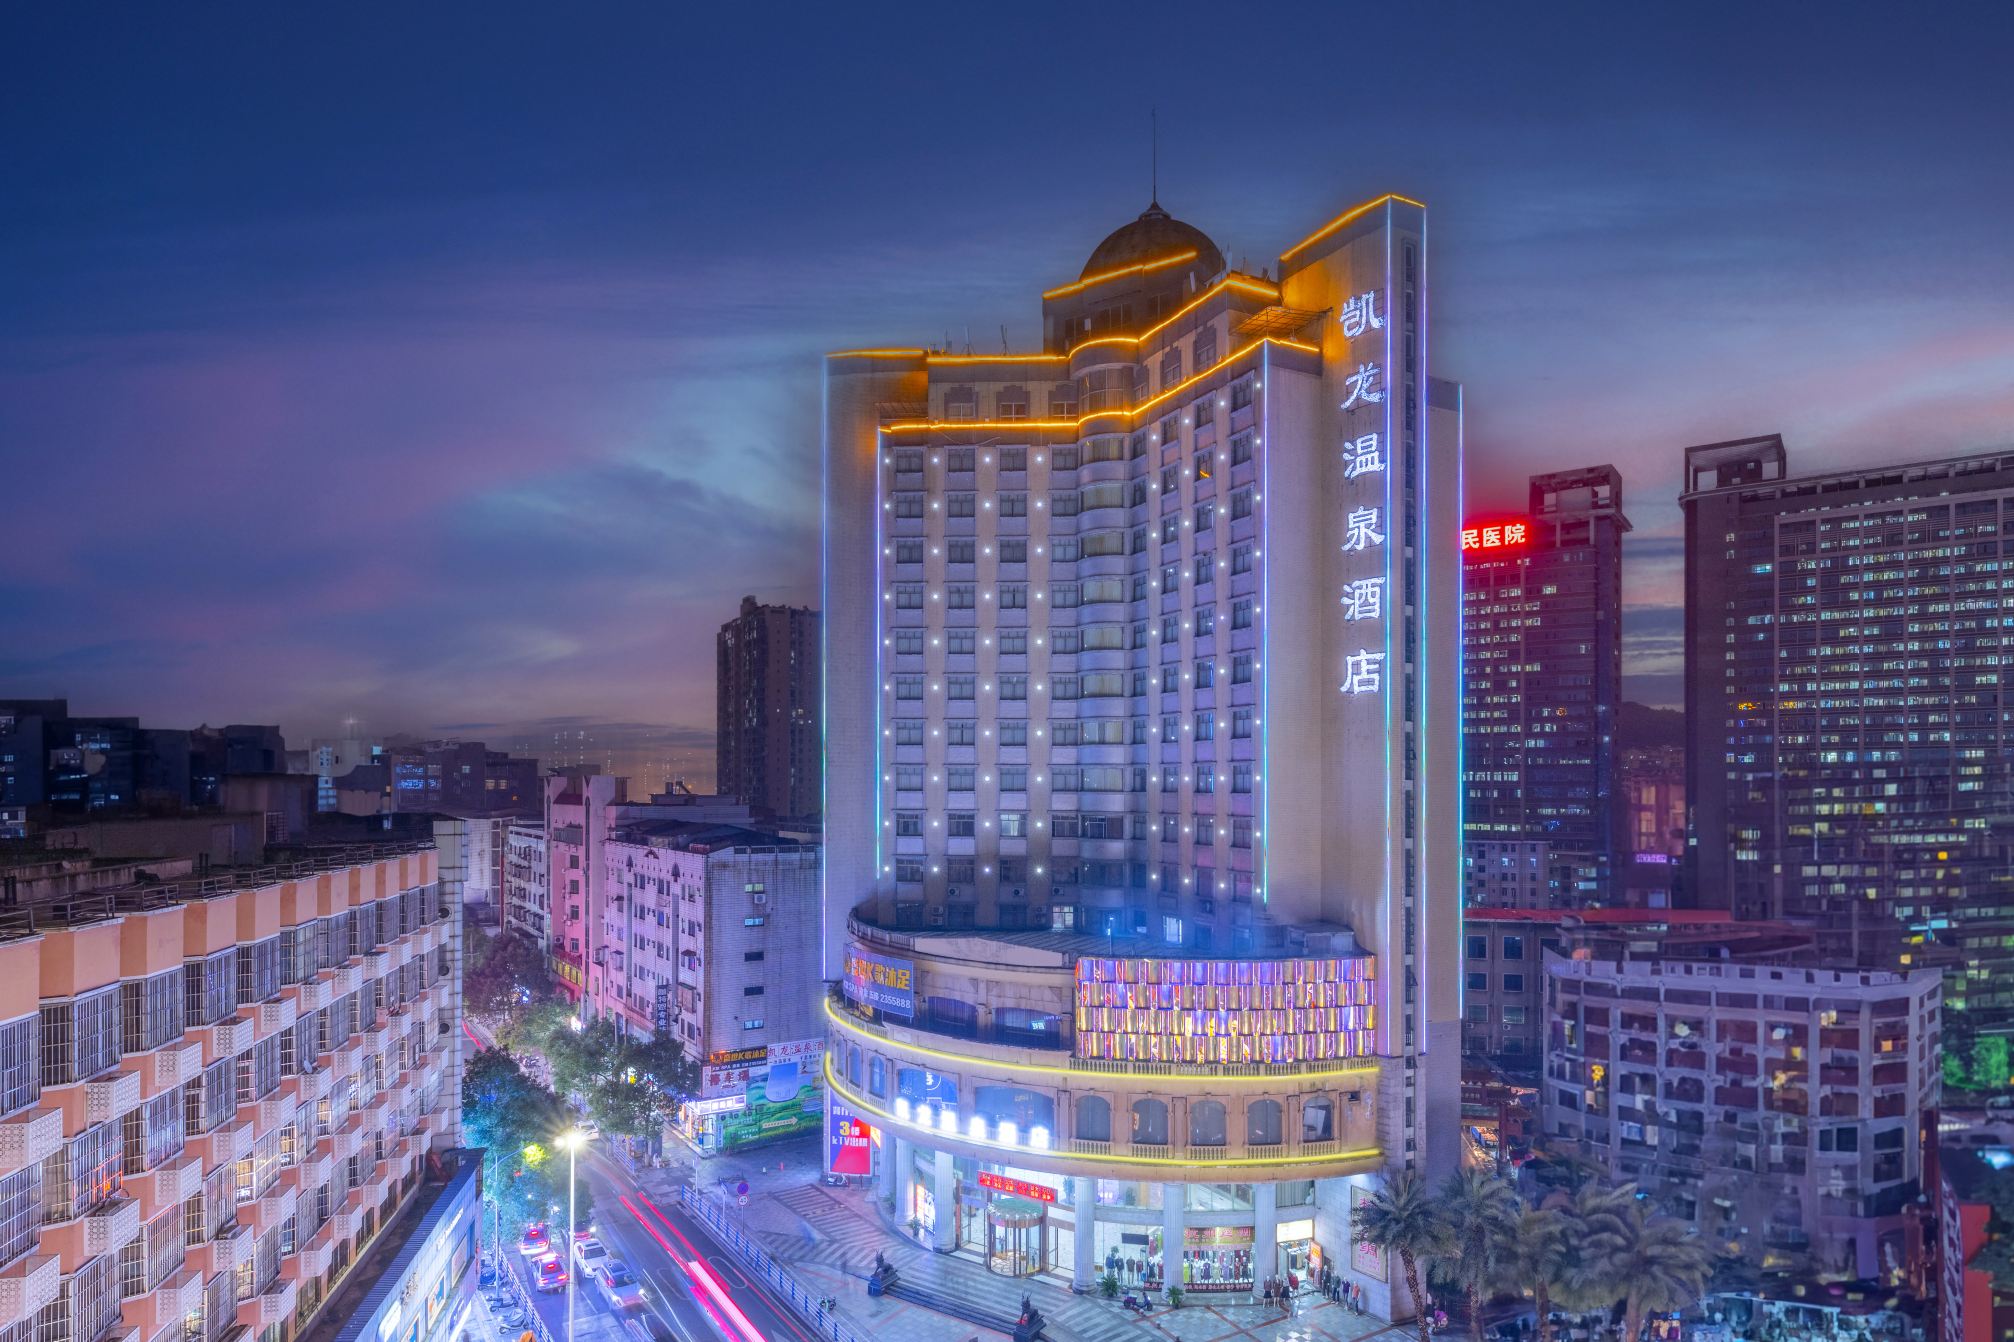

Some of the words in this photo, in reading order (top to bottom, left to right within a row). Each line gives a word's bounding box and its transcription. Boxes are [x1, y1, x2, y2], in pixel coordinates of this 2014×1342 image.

[1340, 290, 1386, 695] 凯龙温泉酒店
[1461, 523, 1526, 550] 民医院
[880, 993, 911, 1009] 2355888
